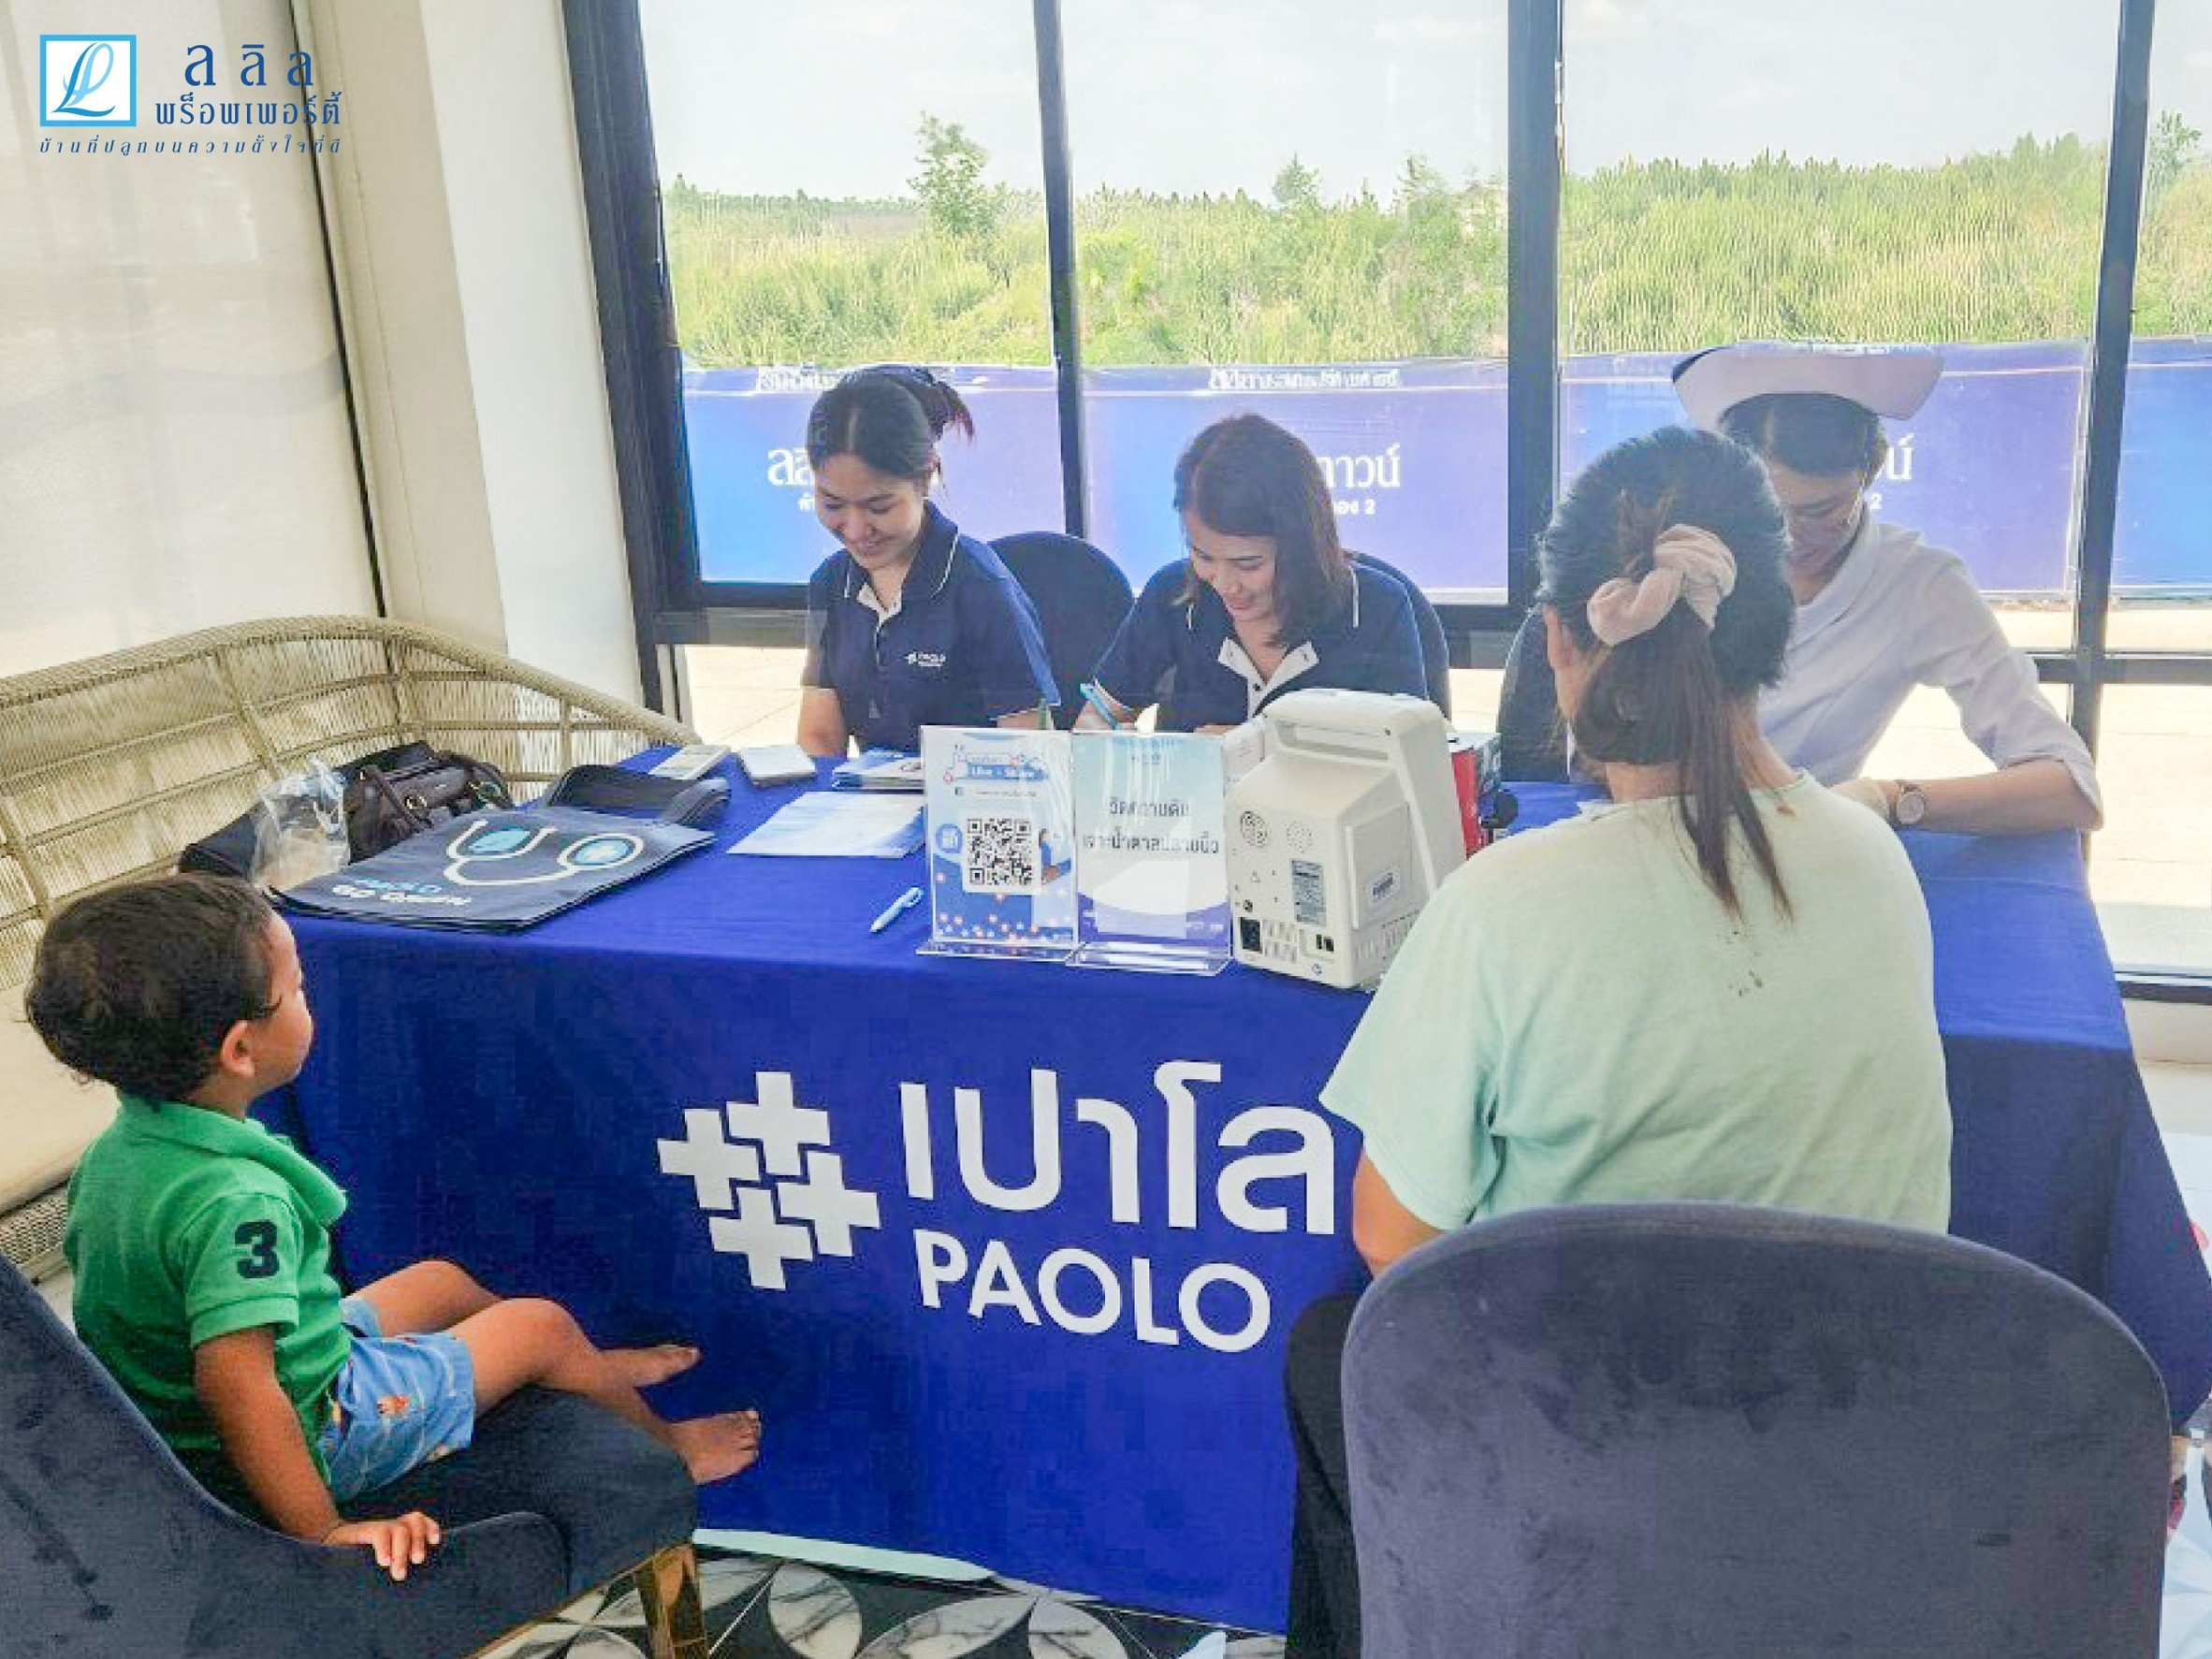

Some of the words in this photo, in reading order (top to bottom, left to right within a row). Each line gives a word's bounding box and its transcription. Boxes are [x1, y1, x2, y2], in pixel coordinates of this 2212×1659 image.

[899, 1058, 1335, 1235] เปาโล
[234, 1219, 280, 1279] 3
[911, 1228, 1272, 1354] PAOLO
